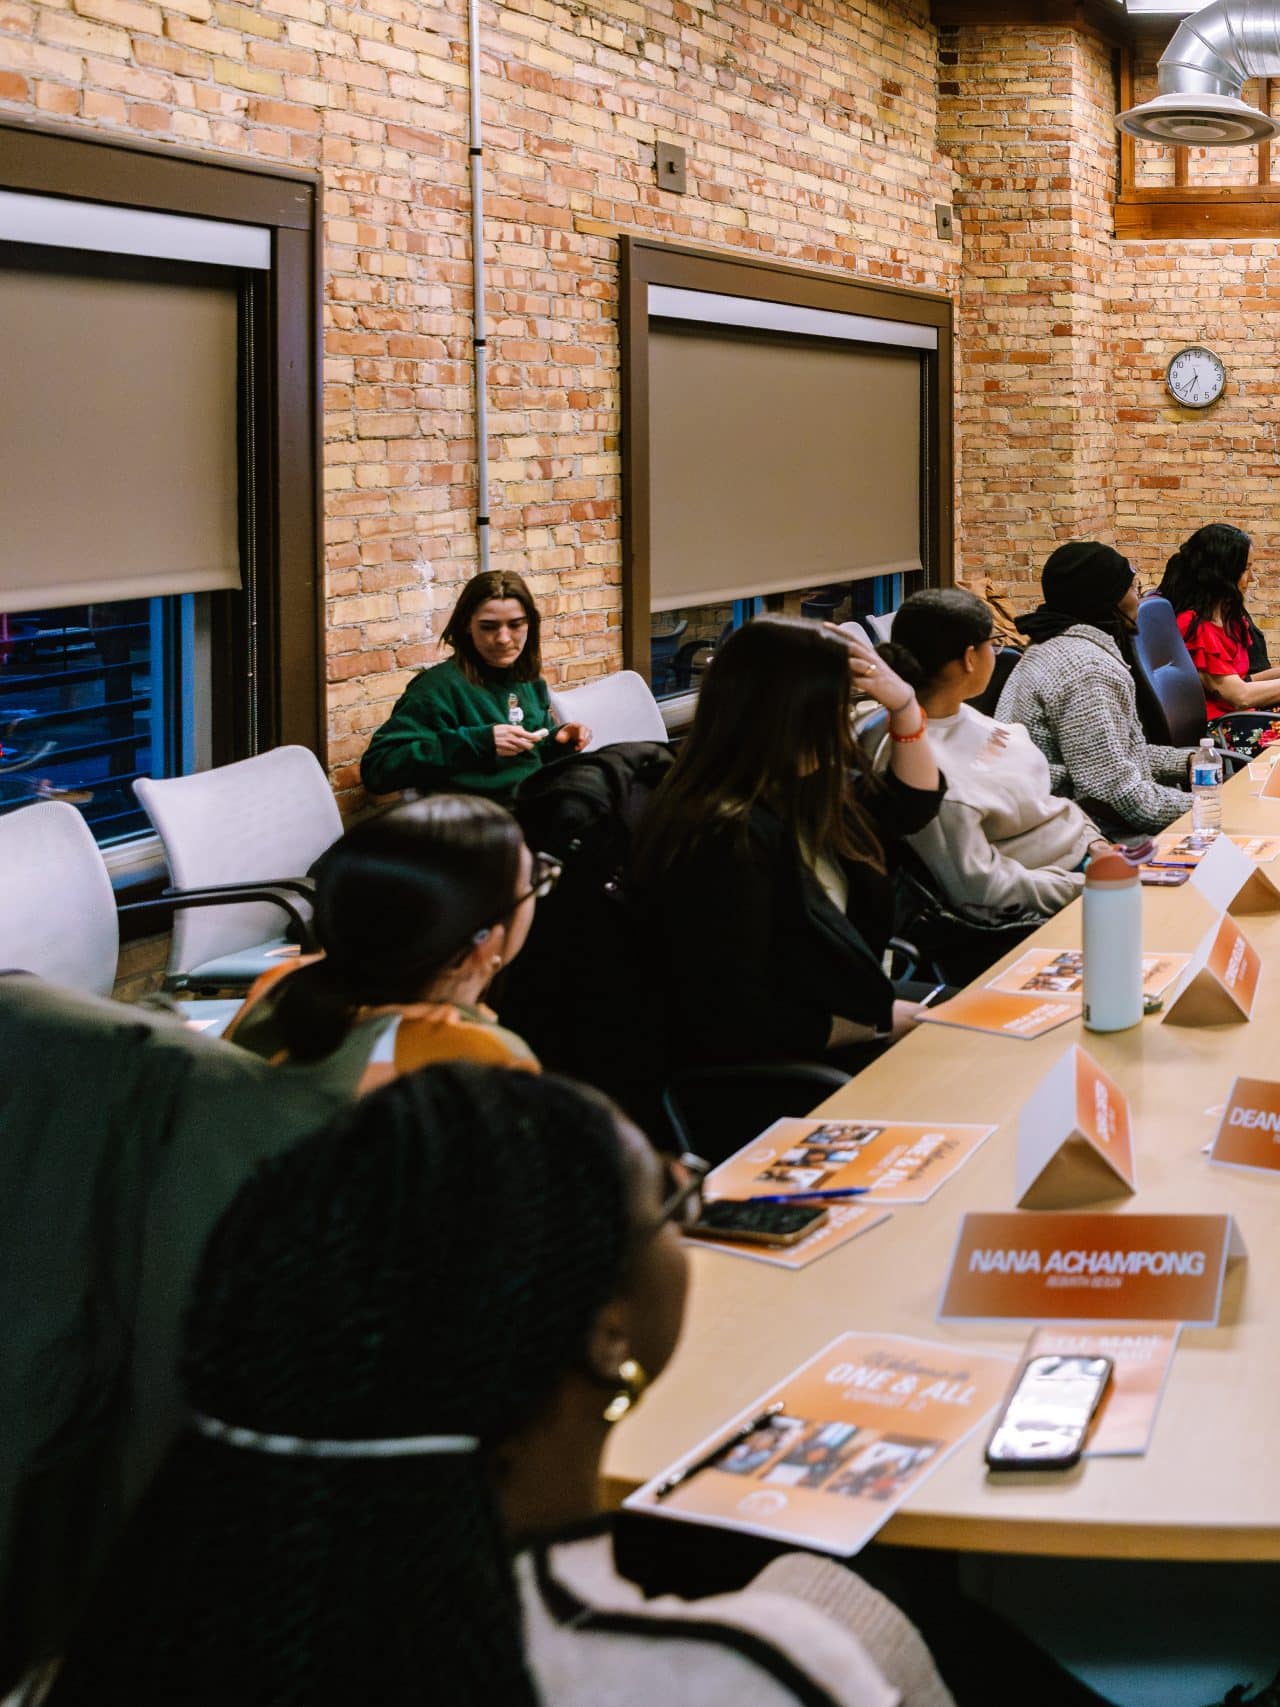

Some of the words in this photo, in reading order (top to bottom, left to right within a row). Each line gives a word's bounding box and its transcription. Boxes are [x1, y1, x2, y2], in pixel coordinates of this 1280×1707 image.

[968, 1248, 1041, 1273] NANA
[1043, 1249, 1206, 1275] ACHAMPONG
[825, 1362, 896, 1391] ONE
[917, 1379, 977, 1406] ALL
